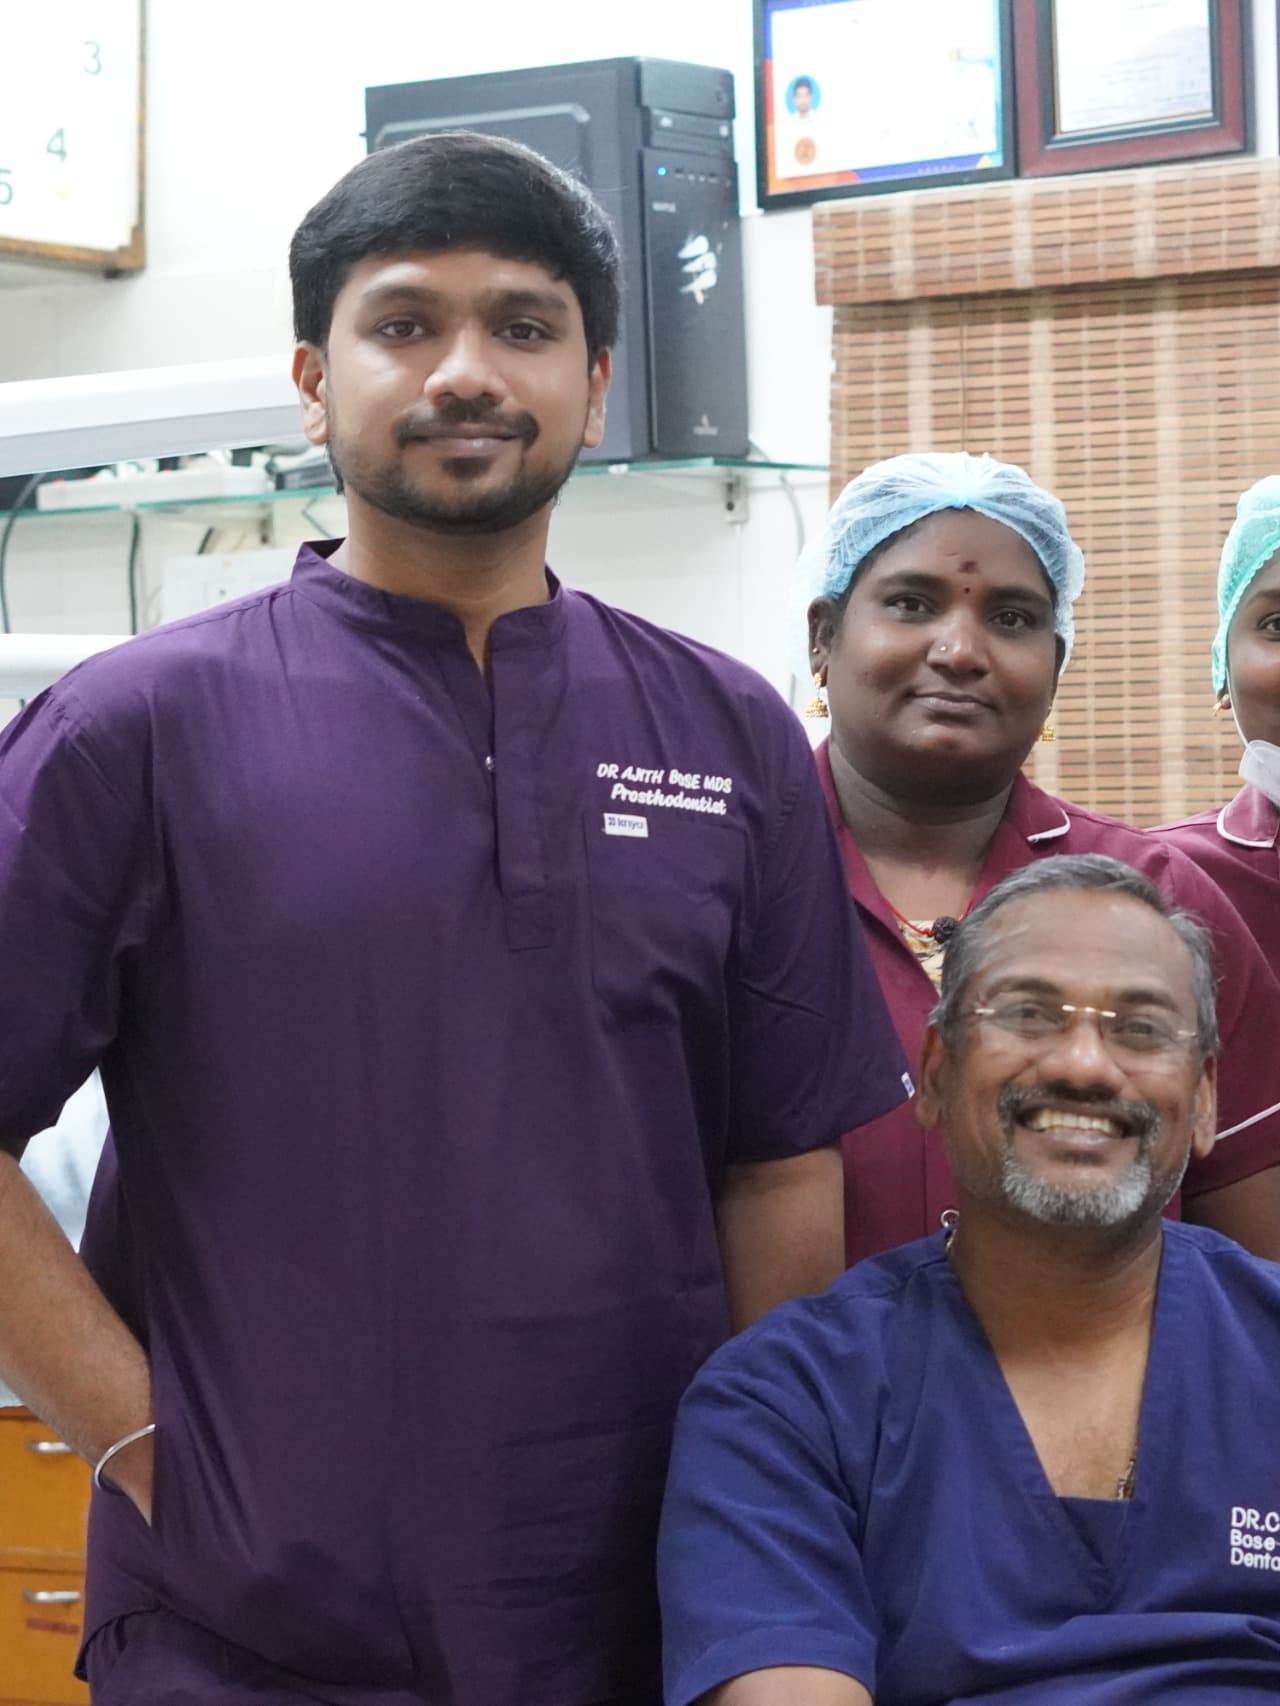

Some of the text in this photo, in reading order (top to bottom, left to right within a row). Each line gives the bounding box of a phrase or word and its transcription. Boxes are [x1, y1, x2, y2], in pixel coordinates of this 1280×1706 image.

[82, 40, 102, 75] 3
[46, 127, 67, 162] 4
[596, 763, 619, 779] DR
[1230, 1529, 1276, 1551] Bose
